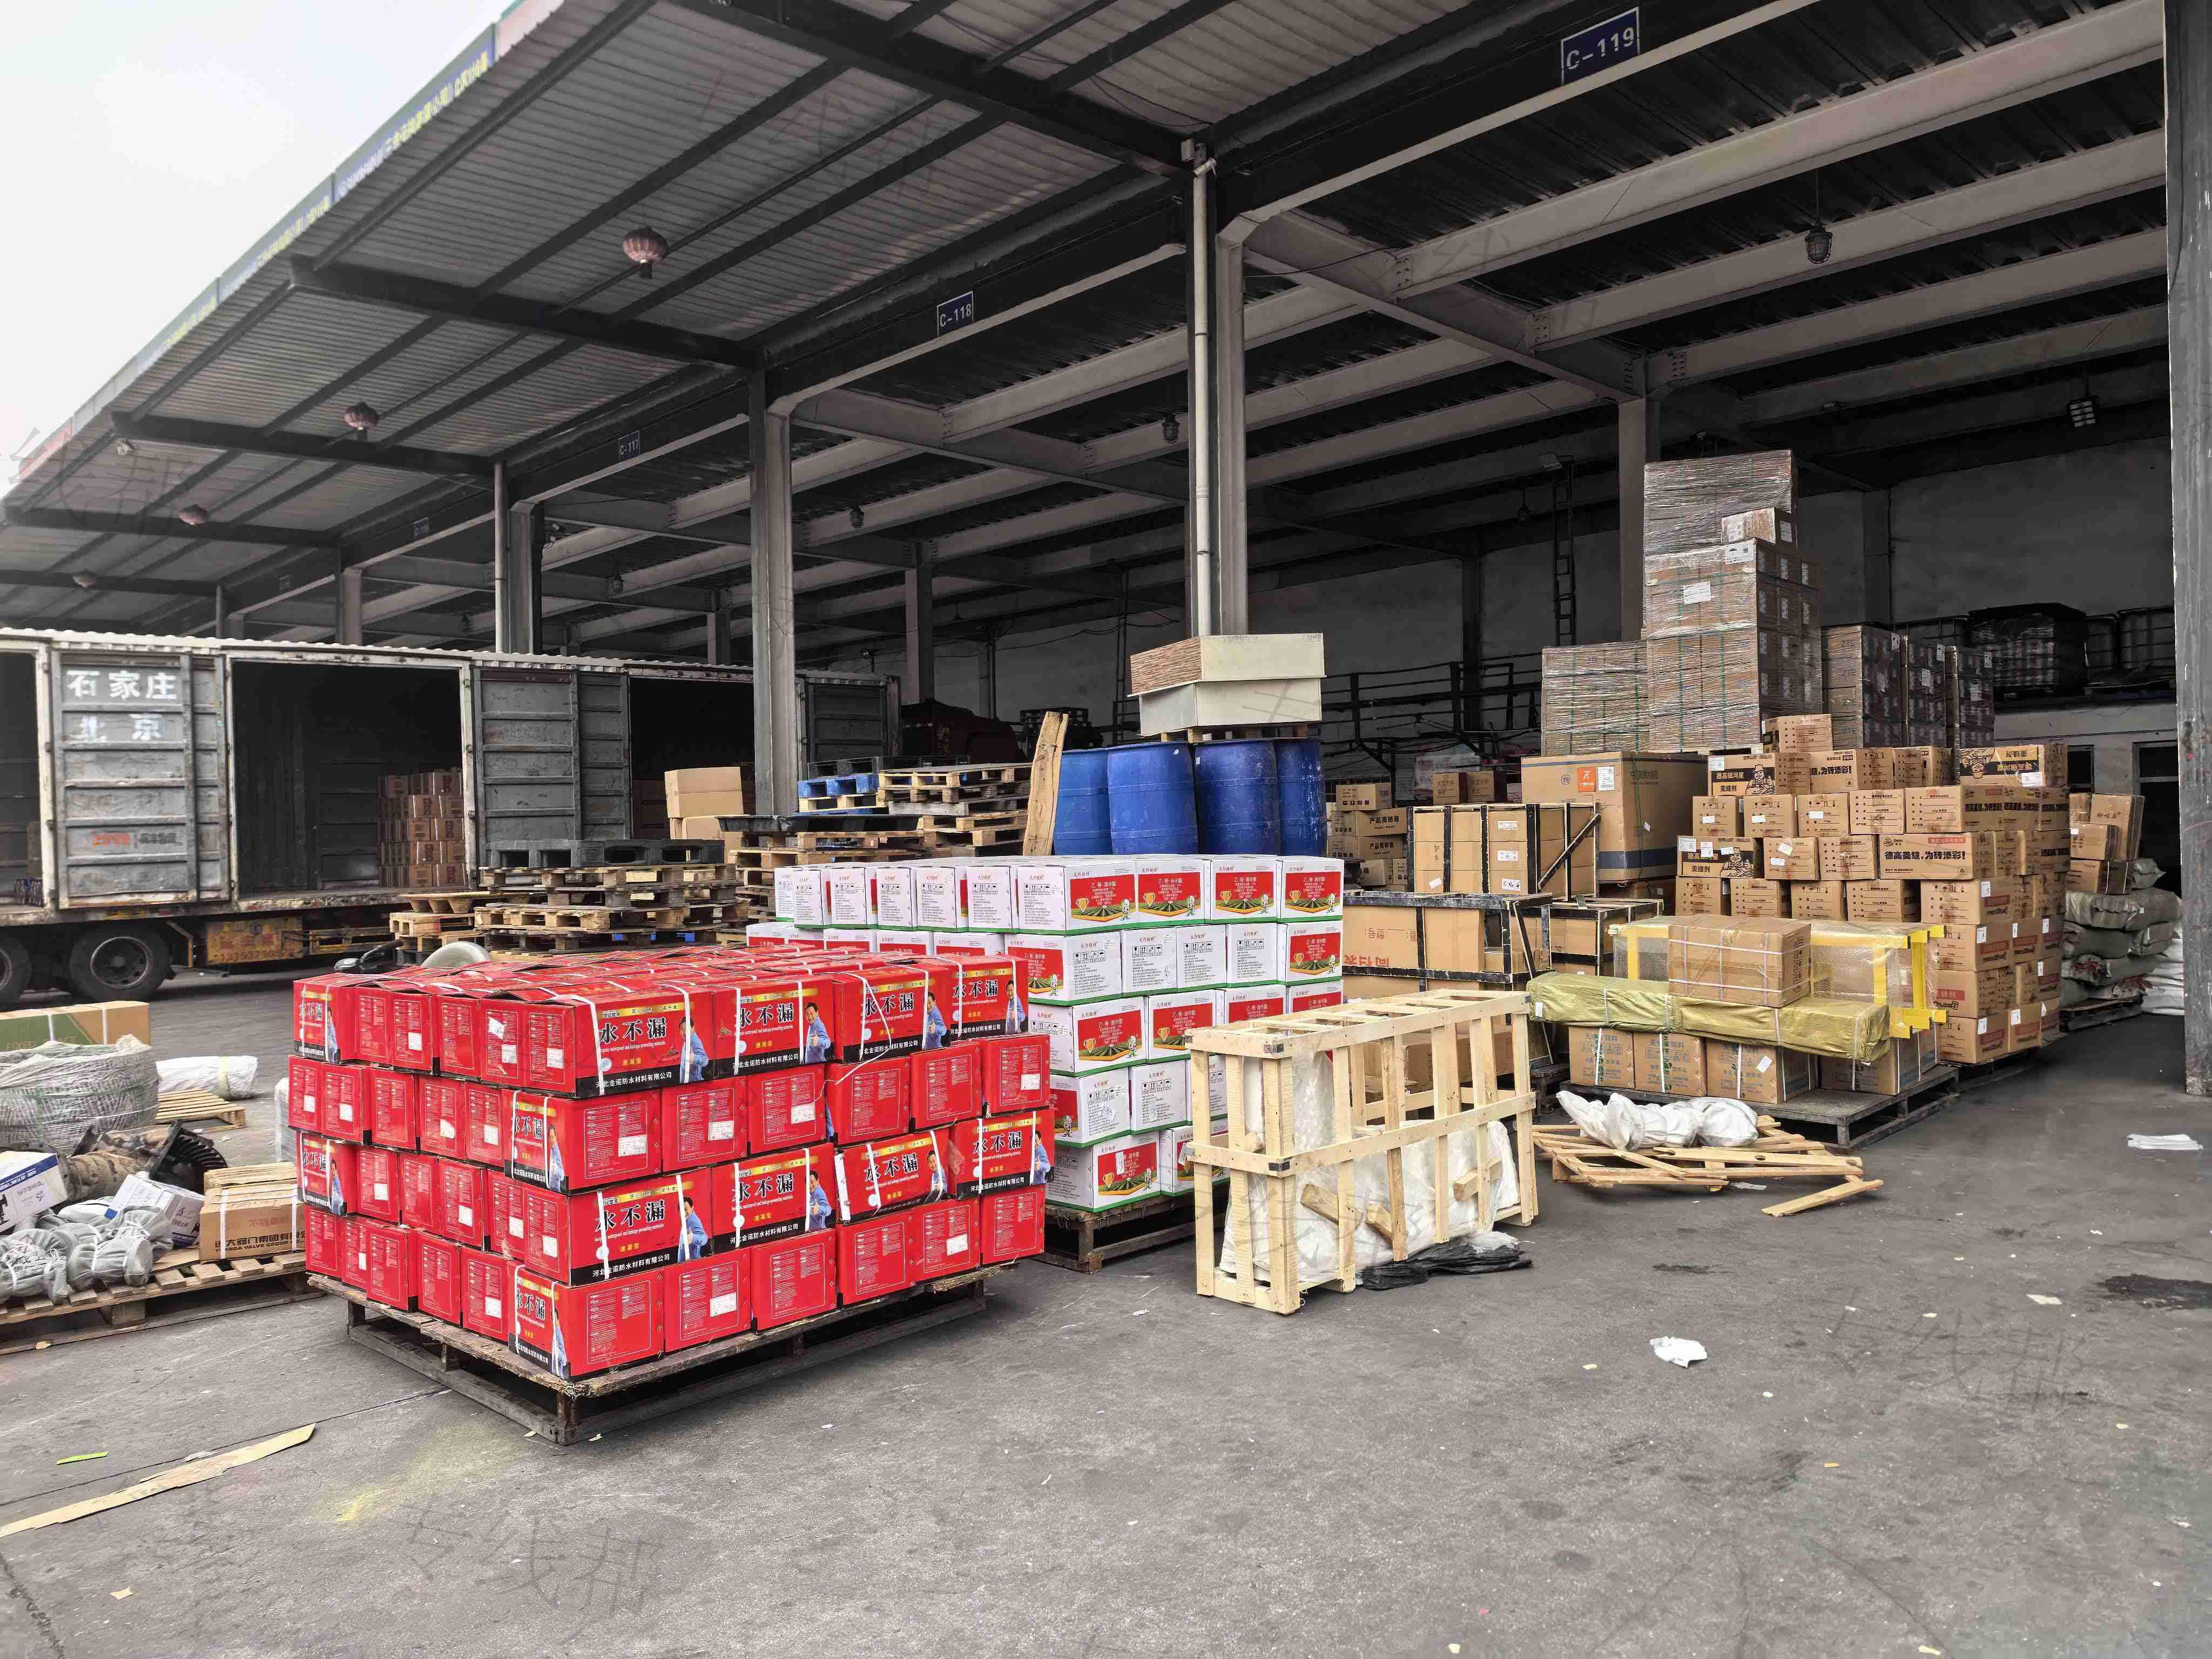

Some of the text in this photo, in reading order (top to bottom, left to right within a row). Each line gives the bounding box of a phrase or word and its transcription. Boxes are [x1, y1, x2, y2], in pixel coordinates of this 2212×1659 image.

[1566, 27, 1635, 69] C-119
[939, 304, 972, 328] C-118
[620, 439, 638, 455] C-117
[66, 670, 177, 699] 石家庄
[734, 1002, 794, 1028] 水不漏
[597, 1017, 666, 1044] 水不漏
[973, 1131, 1022, 1155] 水不漏
[864, 1153, 918, 1183] 水不漏
[732, 1172, 794, 1203] 水不漏
[595, 1199, 665, 1232] 水不漏
